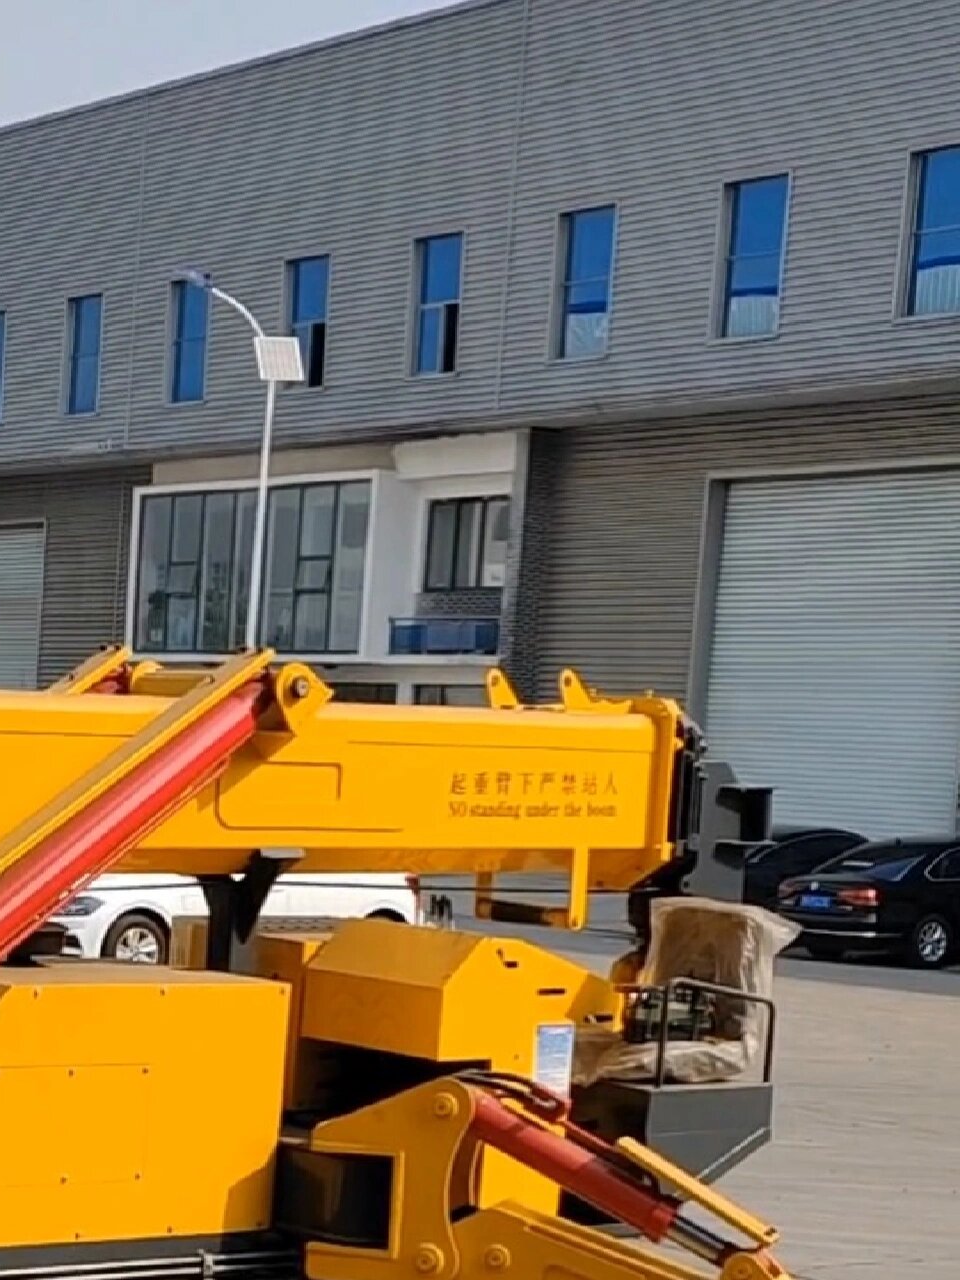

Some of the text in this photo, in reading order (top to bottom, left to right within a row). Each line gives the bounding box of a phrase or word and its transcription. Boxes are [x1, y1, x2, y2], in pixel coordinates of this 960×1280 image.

[450, 771, 618, 796] 起重臂下严禁站人
[449, 801, 617, 819] NO standing under the boom
